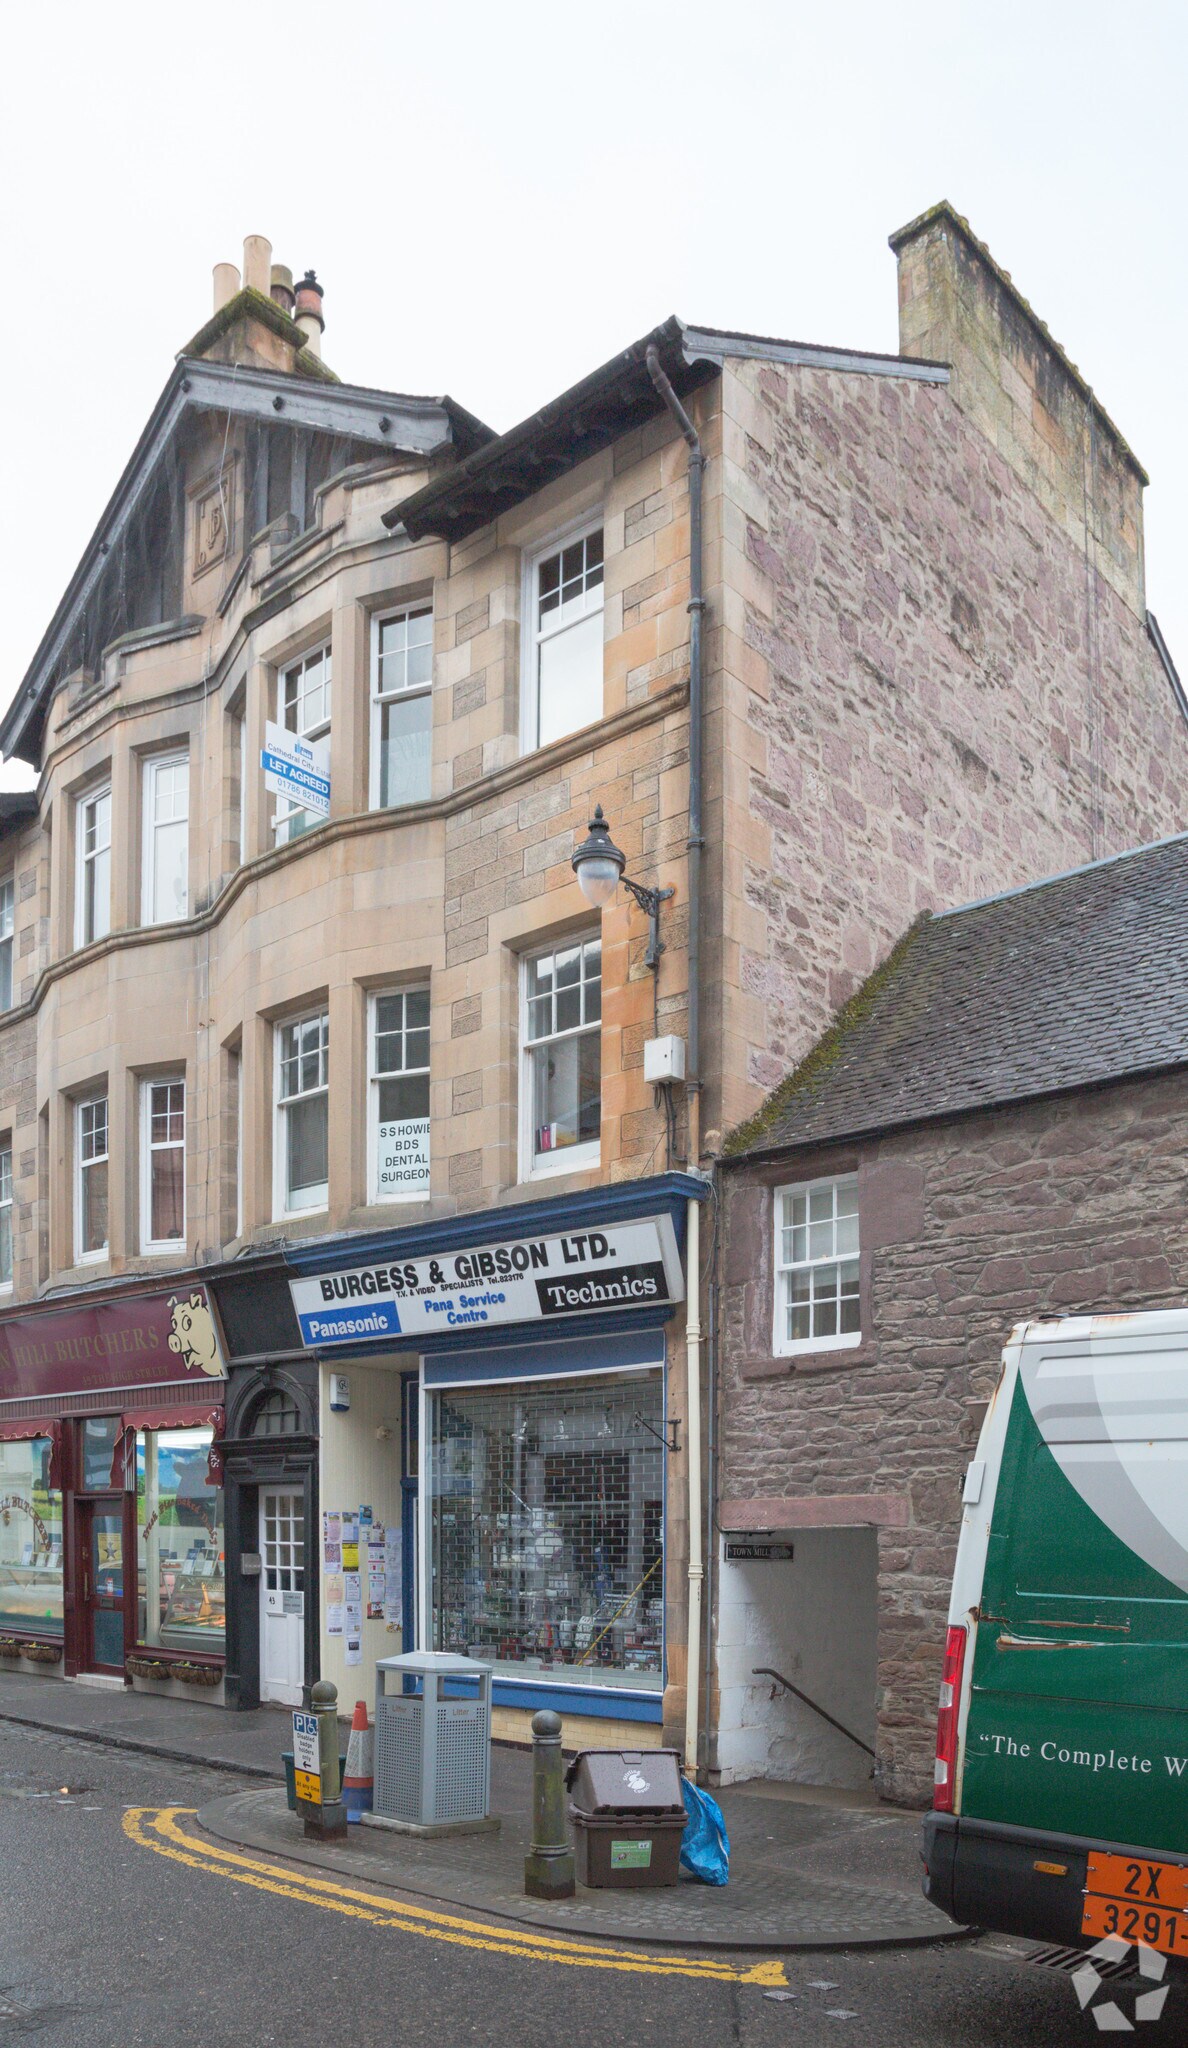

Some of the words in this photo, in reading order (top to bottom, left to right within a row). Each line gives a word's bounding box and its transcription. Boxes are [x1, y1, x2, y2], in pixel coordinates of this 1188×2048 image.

[268, 743, 300, 764] Cathedral
[302, 759, 314, 771] City
[270, 758, 288, 774] LET
[290, 768, 328, 794] AGREED
[380, 1128, 387, 1138] S
[389, 1126, 396, 1136] S
[396, 1139, 419, 1151] BDS
[385, 1154, 428, 1167] DENTAL
[320, 1264, 419, 1300] BURGESS
[429, 1260, 446, 1285] &
[454, 1242, 549, 1280] GIBSON
[560, 1232, 617, 1264] LTD.
[416, 1286, 436, 1296] VIDEO
[440, 1278, 484, 1292] SPECIALISTS
[547, 1275, 658, 1307] Technics
[424, 1300, 454, 1313] Pana
[460, 1292, 506, 1308] Service
[308, 1312, 388, 1338] Panasonic
[447, 1309, 488, 1325] Centre
[14, 1341, 52, 1367] HILL
[55, 1326, 160, 1362] BUTCHERS
[732, 1547, 752, 1556] TOWN
[754, 1547, 769, 1556] MILL
[392, 1705, 407, 1714] Litter
[452, 1708, 470, 1716] Litter
[296, 1716, 303, 1730] P
[296, 1732, 315, 1742] Disabled
[298, 1747, 314, 1756] holders
[302, 1754, 311, 1762] only
[1040, 1742, 1152, 1774] Complete
[1124, 1863, 1163, 1899] 2X
